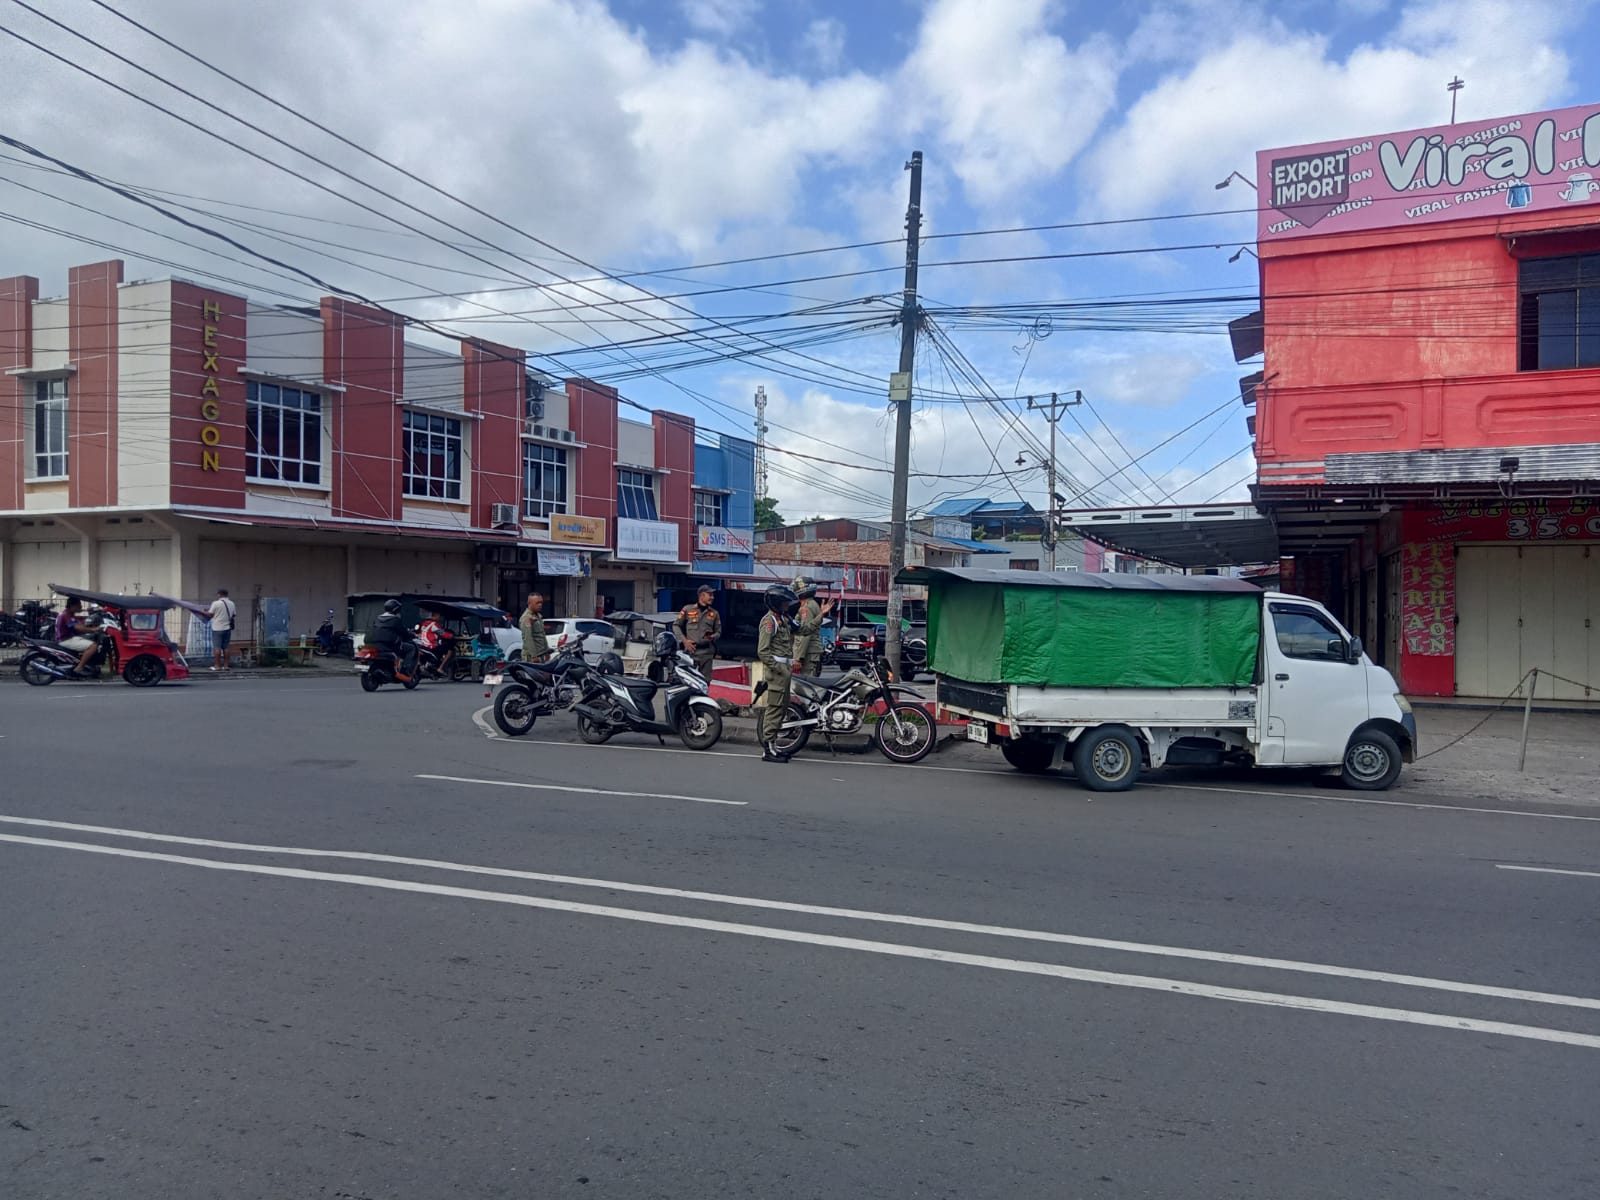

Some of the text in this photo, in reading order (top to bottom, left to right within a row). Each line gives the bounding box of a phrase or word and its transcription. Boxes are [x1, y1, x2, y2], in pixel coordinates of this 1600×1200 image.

[1274, 153, 1347, 185] EXPORT
[1378, 118, 1556, 192] Viral
[1276, 174, 1346, 206] IMPORT
[1405, 199, 1452, 218] VIRAL
[201, 299, 220, 473] HEXAGON
[709, 532, 726, 545] SMS
